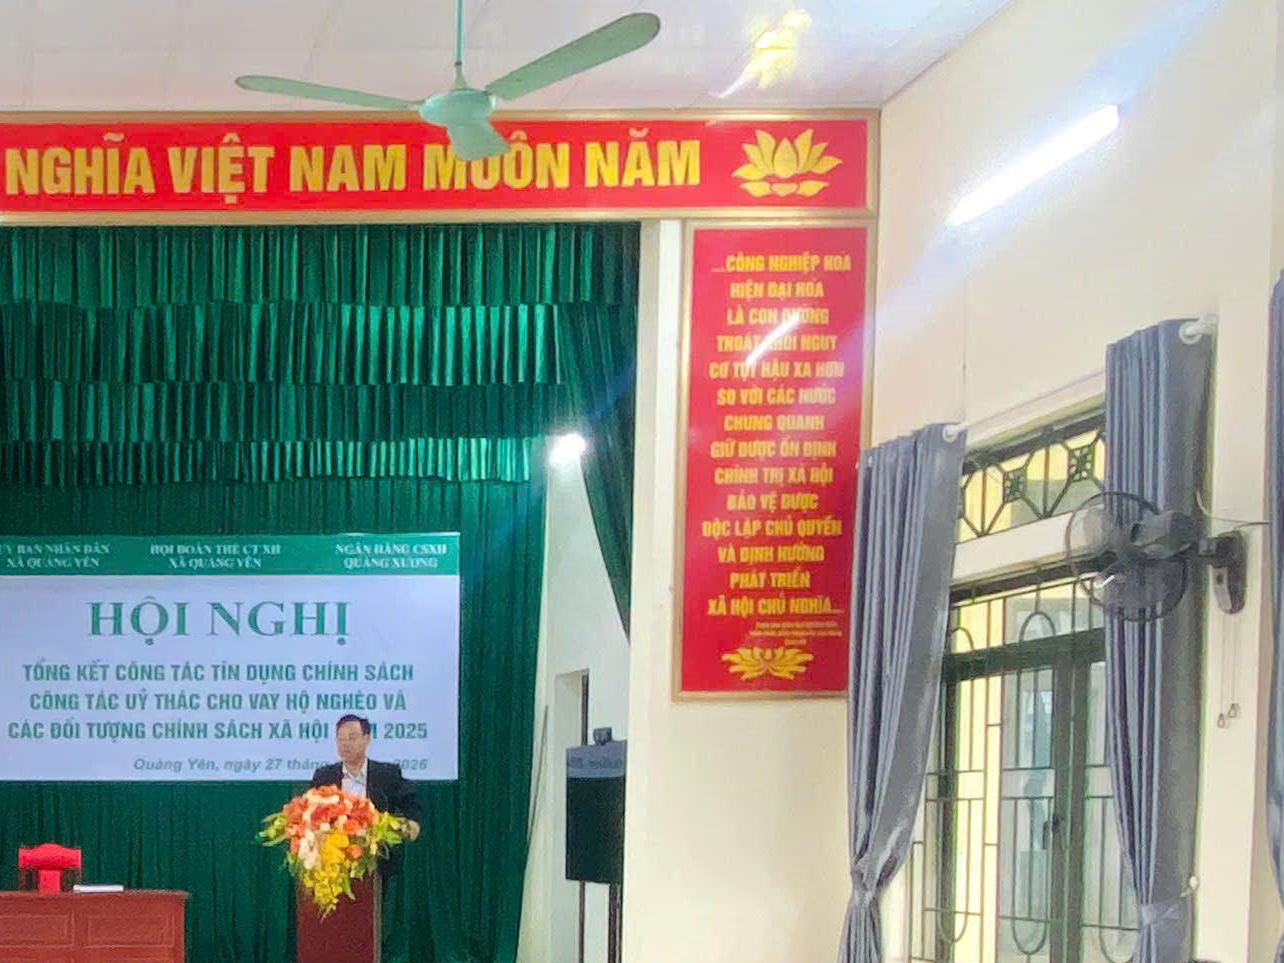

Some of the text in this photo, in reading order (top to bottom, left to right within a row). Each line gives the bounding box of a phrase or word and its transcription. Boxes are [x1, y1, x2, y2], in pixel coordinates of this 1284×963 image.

[6, 134, 155, 196] NGHĨA
[167, 132, 273, 203] VIỆT
[288, 143, 406, 192] NAM
[423, 130, 569, 190] MUÔN
[584, 127, 700, 188] NĂM
[730, 278, 764, 302] HIỆN
[767, 282, 792, 300] ĐẠI
[727, 304, 745, 325] LÀ
[749, 308, 777, 325] CON
[800, 335, 837, 351] NGUY
[793, 362, 811, 378] XA
[717, 388, 736, 405] SO
[767, 384, 795, 404] CÁC
[724, 414, 824, 431] CHUNG QUANH
[714, 462, 833, 488] CHÍNH TRỊ XÃ HỘI
[760, 491, 777, 512] VỆ
[735, 518, 761, 540] LẬP
[766, 515, 793, 536] CHỦ
[263, 544, 281, 555] XH
[412, 543, 447, 554] CSXH
[718, 543, 736, 563] VÀ
[74, 555, 100, 568] YÊN
[236, 555, 262, 568] YÊN
[343, 555, 389, 569] QUẢNG
[730, 569, 766, 589] PHÁT
[708, 595, 726, 615] XÃ
[731, 595, 753, 618] HỘI
[758, 591, 786, 614] CHỦ
[87, 595, 352, 646] HỘI NGHỊ
[23, 658, 414, 685] TỔNG KẾT CÔNG TÁC TÍN DỤNG CHÍNH SÁCH
[30, 690, 79, 710] CÔNG
[85, 690, 120, 710] TÁC
[154, 690, 201, 710] THÁC
[206, 693, 243, 710] CHO
[249, 693, 279, 710] VAY
[286, 690, 310, 714] HỘ
[316, 690, 377, 710] NGHÈO
[384, 690, 407, 710] VÀ
[8, 719, 44, 739] CÁC
[50, 717, 80, 739] ĐỐI
[86, 721, 146, 743] TƯỢNG
[152, 719, 208, 739] CHÍNH
[214, 719, 262, 739] SÁCH
[268, 719, 292, 739] XÃ
[299, 719, 328, 743] HỘI
[384, 722, 428, 739] 2025
[134, 758, 182, 773] Quảng
[224, 758, 261, 774] ngày
[266, 759, 283, 770] 27
